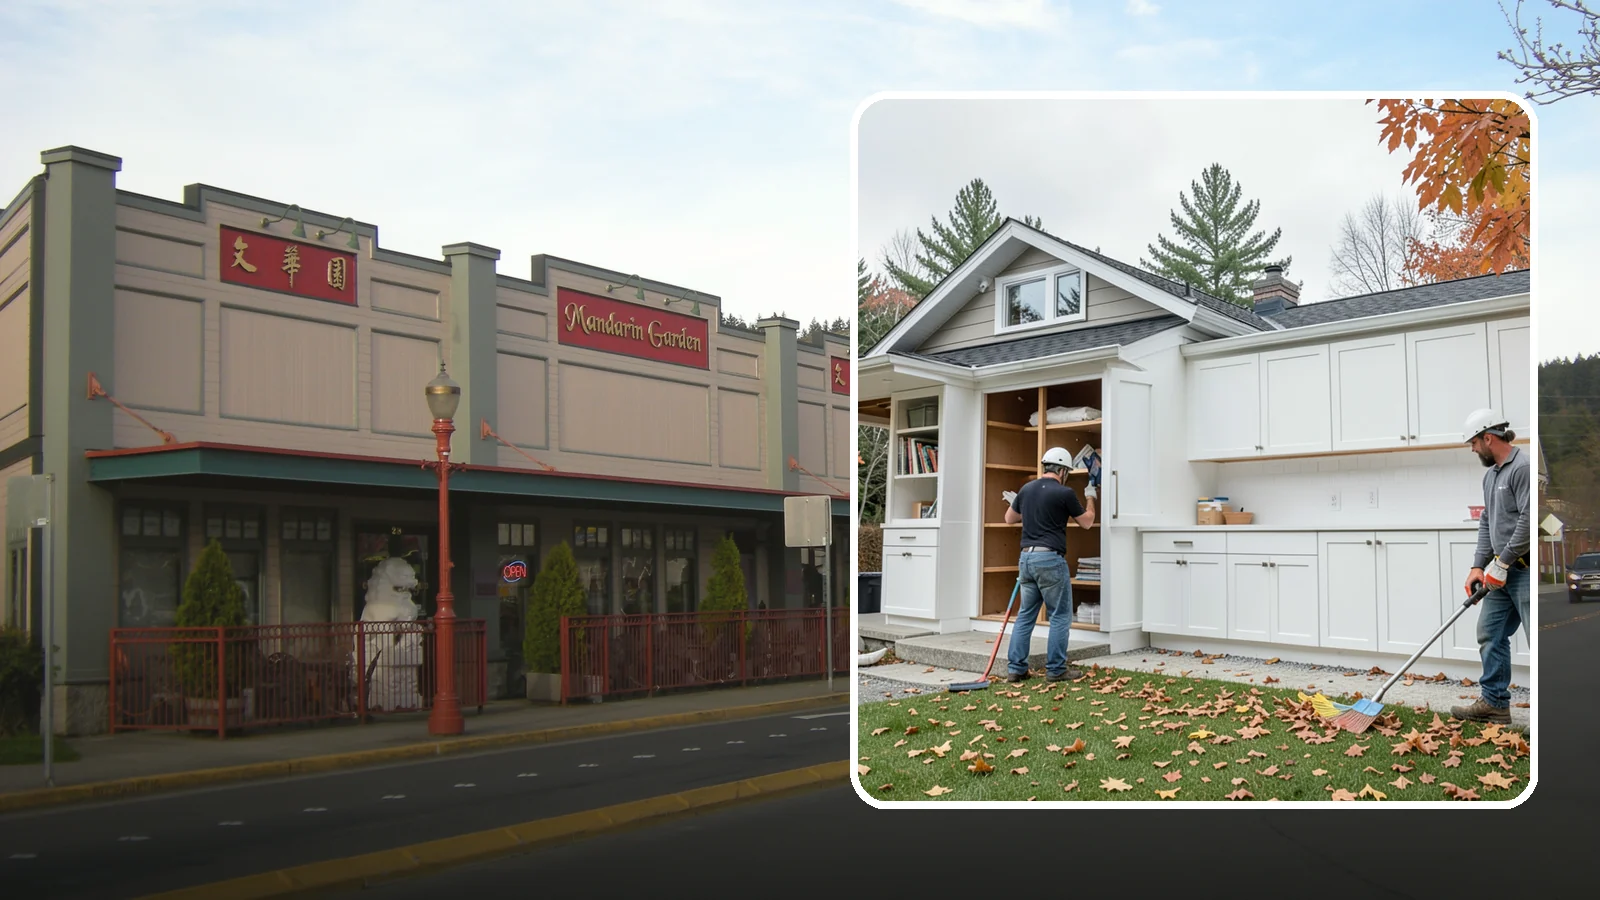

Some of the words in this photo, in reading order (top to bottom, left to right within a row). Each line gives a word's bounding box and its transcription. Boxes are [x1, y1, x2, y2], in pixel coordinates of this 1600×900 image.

[231, 235, 347, 290] 文華園
[564, 302, 644, 341] Mandarin
[648, 320, 701, 352] Garden
[503, 565, 527, 578] OPEN
